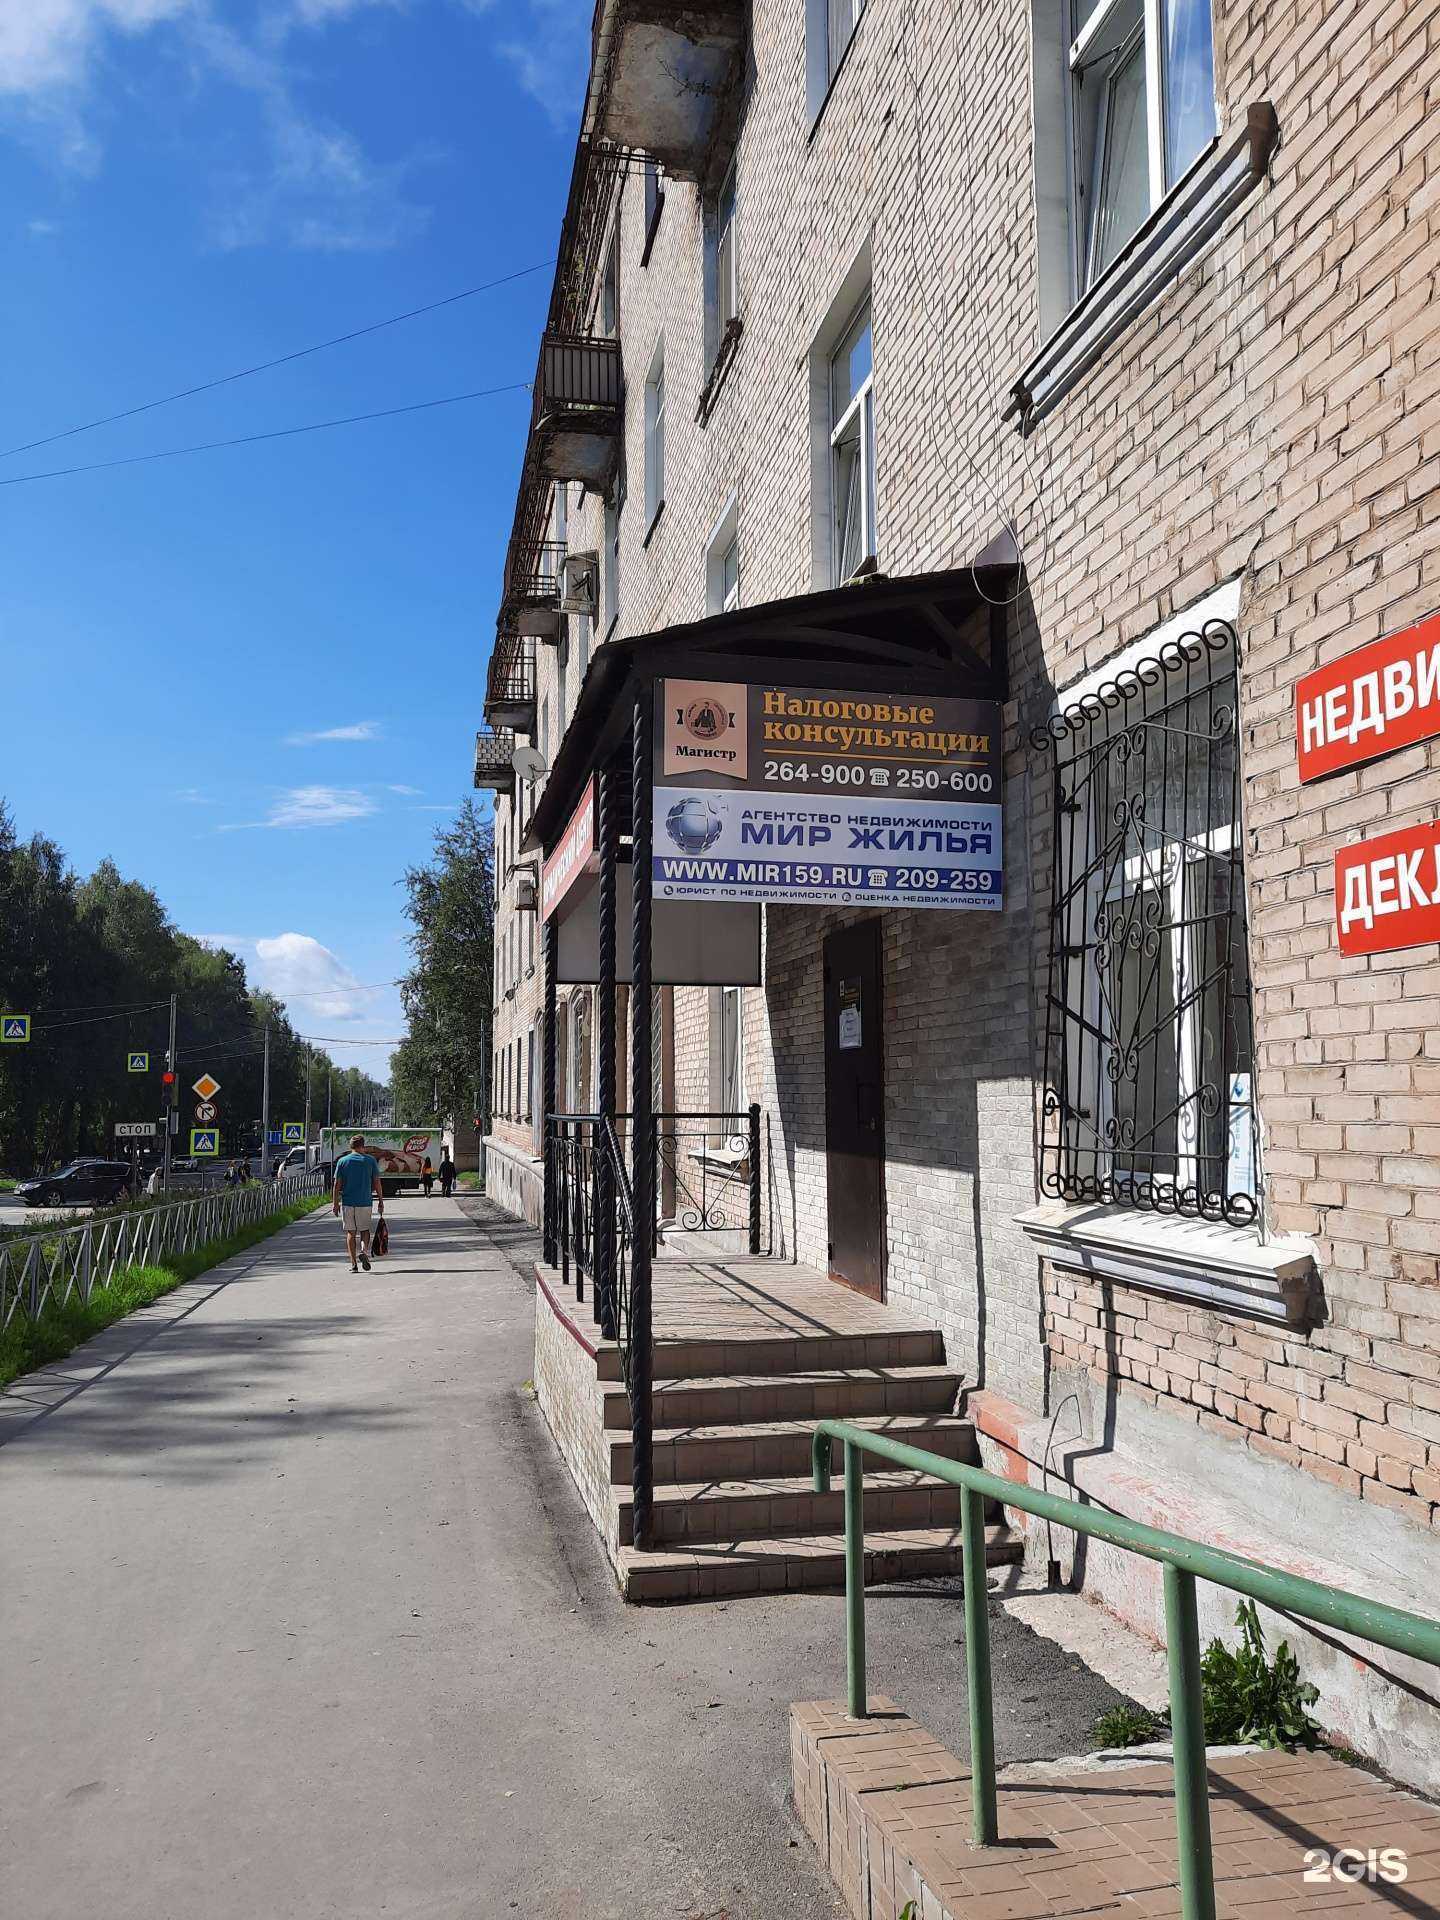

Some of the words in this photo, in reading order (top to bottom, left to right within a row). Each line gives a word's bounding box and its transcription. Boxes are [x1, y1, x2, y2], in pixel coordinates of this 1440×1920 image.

[763, 691, 936, 725] Налоговые
[1303, 641, 1440, 754] НЕДВИ
[675, 745, 737, 762] Магистр
[763, 721, 990, 756] консультации
[764, 761, 865, 786] 264-900
[896, 768, 993, 793] 250-600
[741, 810, 842, 824] АГЕНТСТВО
[847, 815, 993, 832] НЕДВИЖИМОСТИ
[741, 822, 832, 847] МИР
[847, 827, 993, 855] ЖИЛЬЯ
[662, 860, 862, 886] WWW.MIR159.RU
[895, 868, 993, 891] 209-259
[676, 887, 716, 895] ЮРИСТ
[720, 888, 737, 897] ПО
[740, 889, 837, 900] НЕДВИЖИМОСТИ
[855, 894, 899, 903] ОЦЕНКА
[902, 895, 996, 906] НЕДВИЖИМОСТИ
[119, 1125, 151, 1135] СТОП
